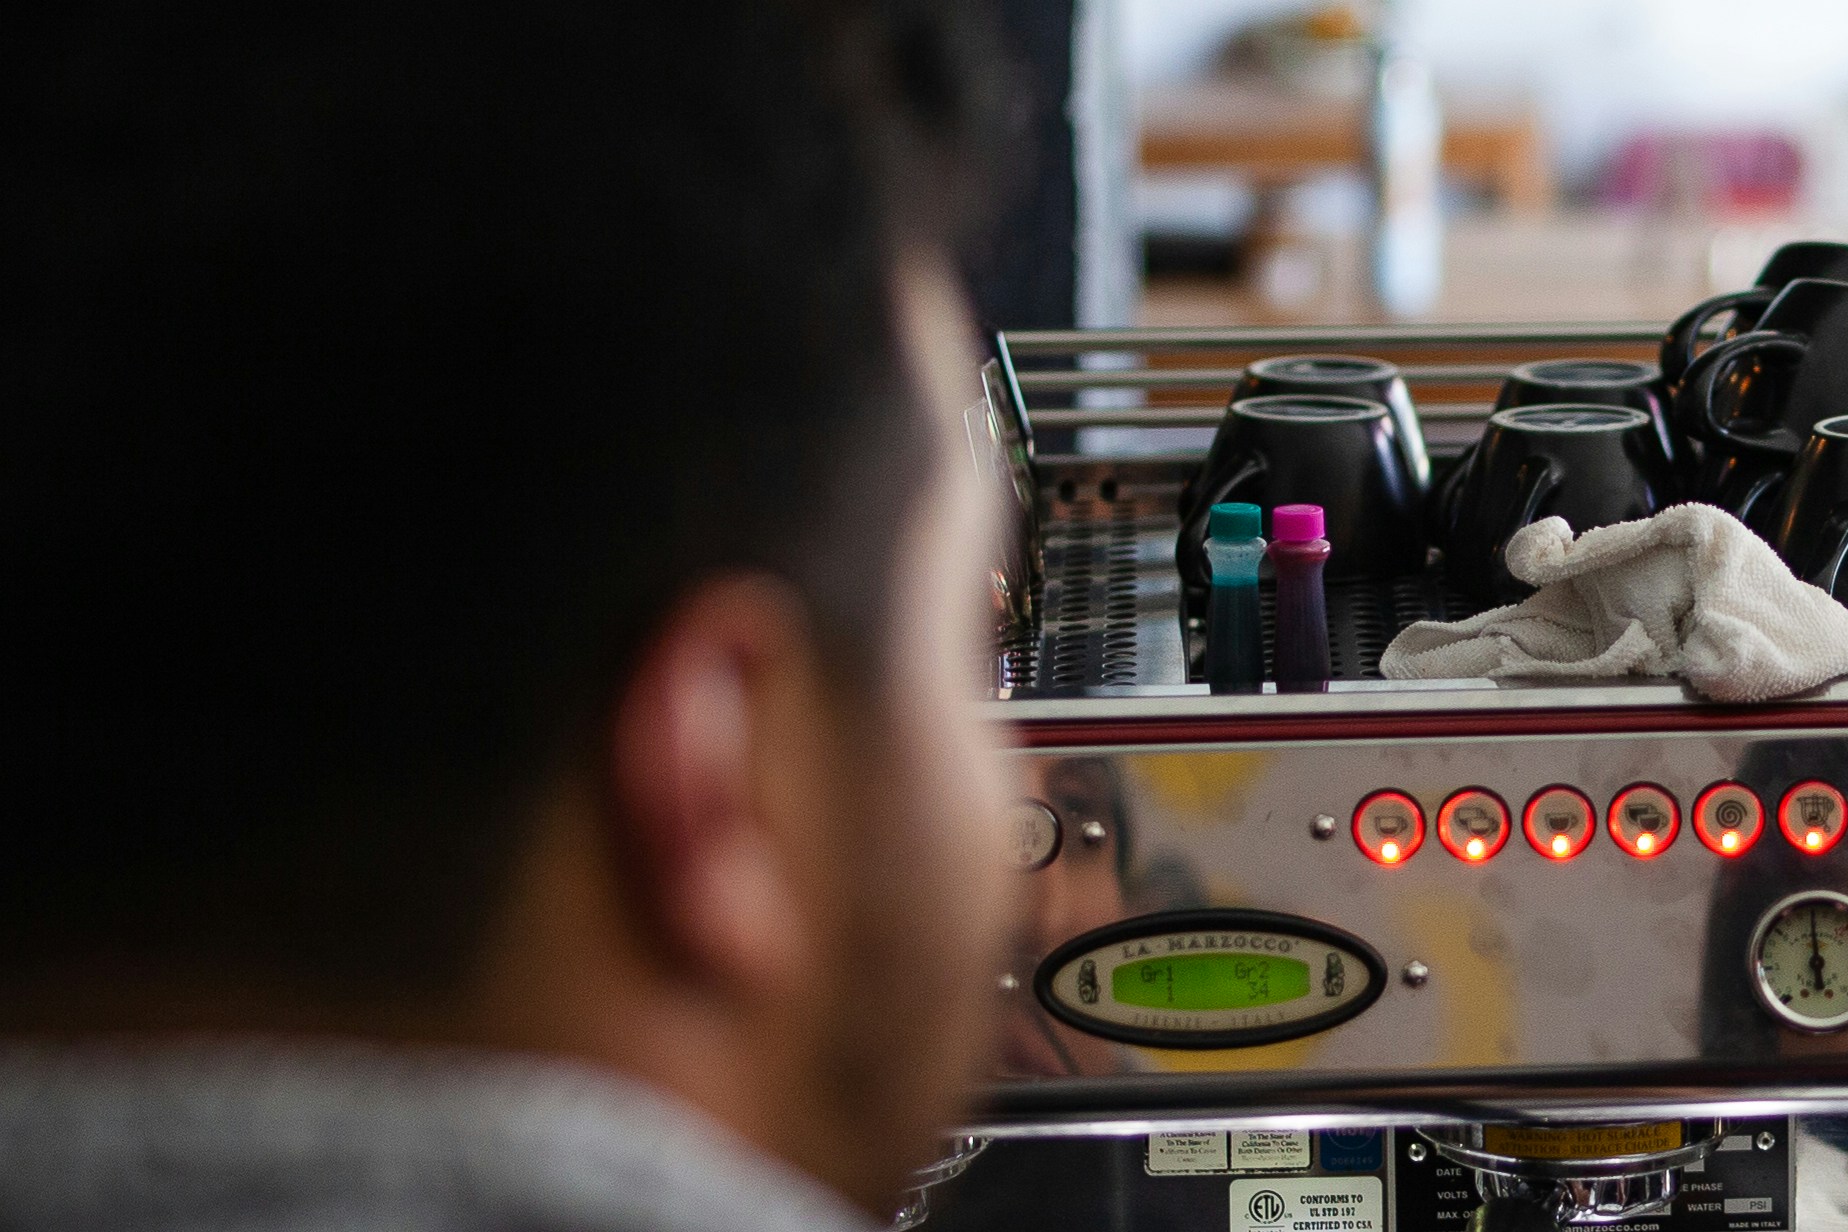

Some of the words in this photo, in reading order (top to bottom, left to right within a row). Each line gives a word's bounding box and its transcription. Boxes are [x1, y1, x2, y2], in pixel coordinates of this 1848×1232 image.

[1122, 942, 1151, 959] LA
[1168, 935, 1292, 953] MARZOCCO
[1249, 982, 1270, 1000] 34
[1577, 1129, 1602, 1142] HOT
[1607, 1127, 1660, 1140] SURFACE
[1571, 1142, 1623, 1154] SURFACE
[1436, 1168, 1462, 1176] DATE
[1691, 1183, 1723, 1192] PHASE
[1300, 1194, 1349, 1205] CONFORMS
[1351, 1194, 1364, 1204] TO
[1437, 1190, 1469, 1199] VOLTS
[1687, 1203, 1722, 1212] WATER
[1749, 1200, 1767, 1210] PSI
[1310, 1208, 1320, 1218] UL
[1322, 1207, 1339, 1217] STD
[1341, 1207, 1356, 1217] 197
[1293, 1221, 1341, 1231] CERTIFIED
[1343, 1221, 1354, 1230] TO
[1356, 1220, 1373, 1230] CSA
